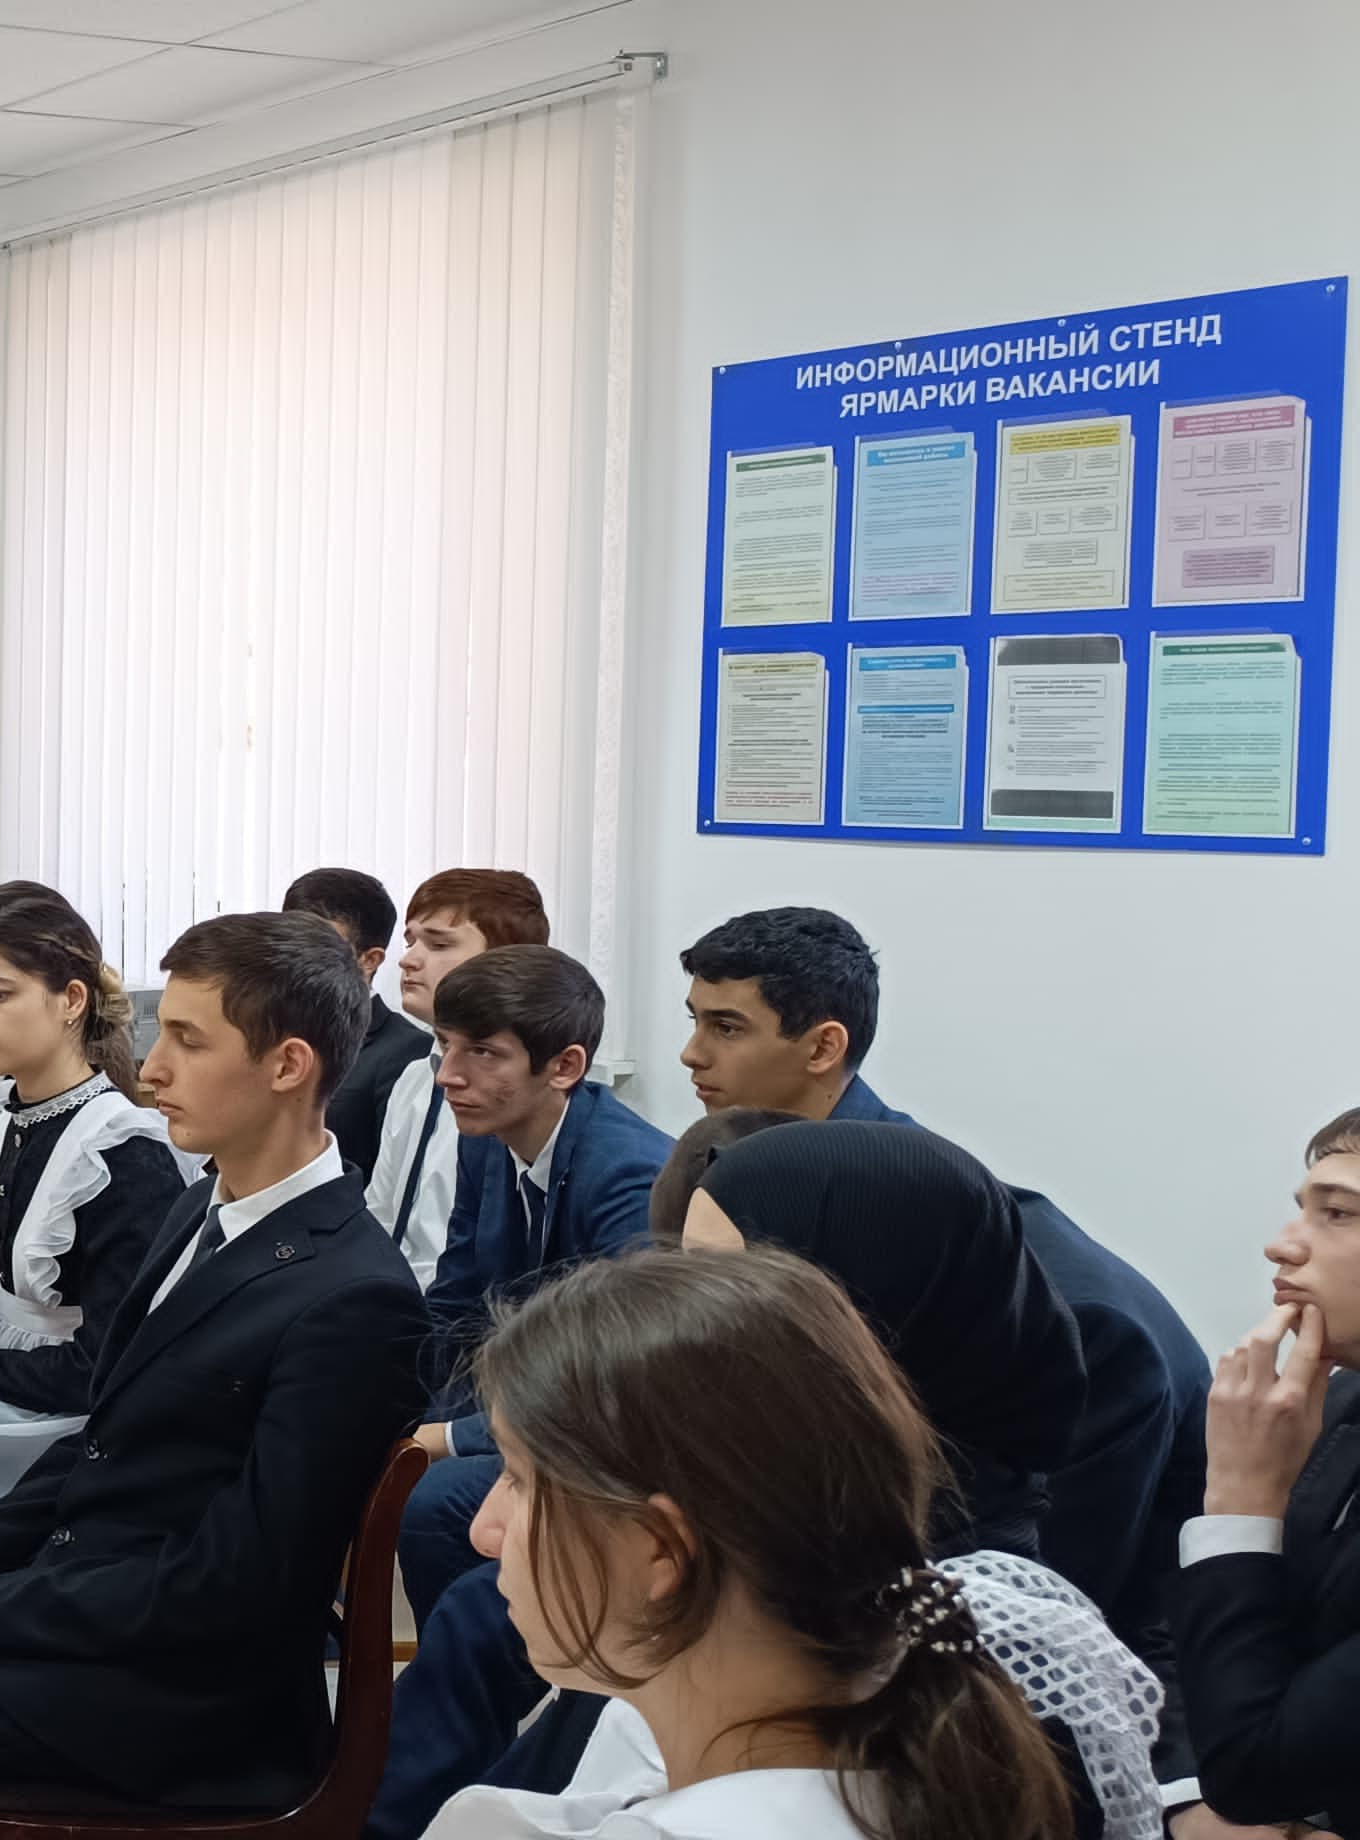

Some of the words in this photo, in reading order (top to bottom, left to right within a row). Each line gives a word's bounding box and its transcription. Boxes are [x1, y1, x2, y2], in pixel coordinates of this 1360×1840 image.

[795, 323, 1100, 391] ИНФОРМАЦИОННЫЙ
[1109, 313, 1223, 352] СТЕНД
[838, 380, 978, 419] ЯРМАРКИ
[985, 358, 1161, 403] ВАКАНСИИ
